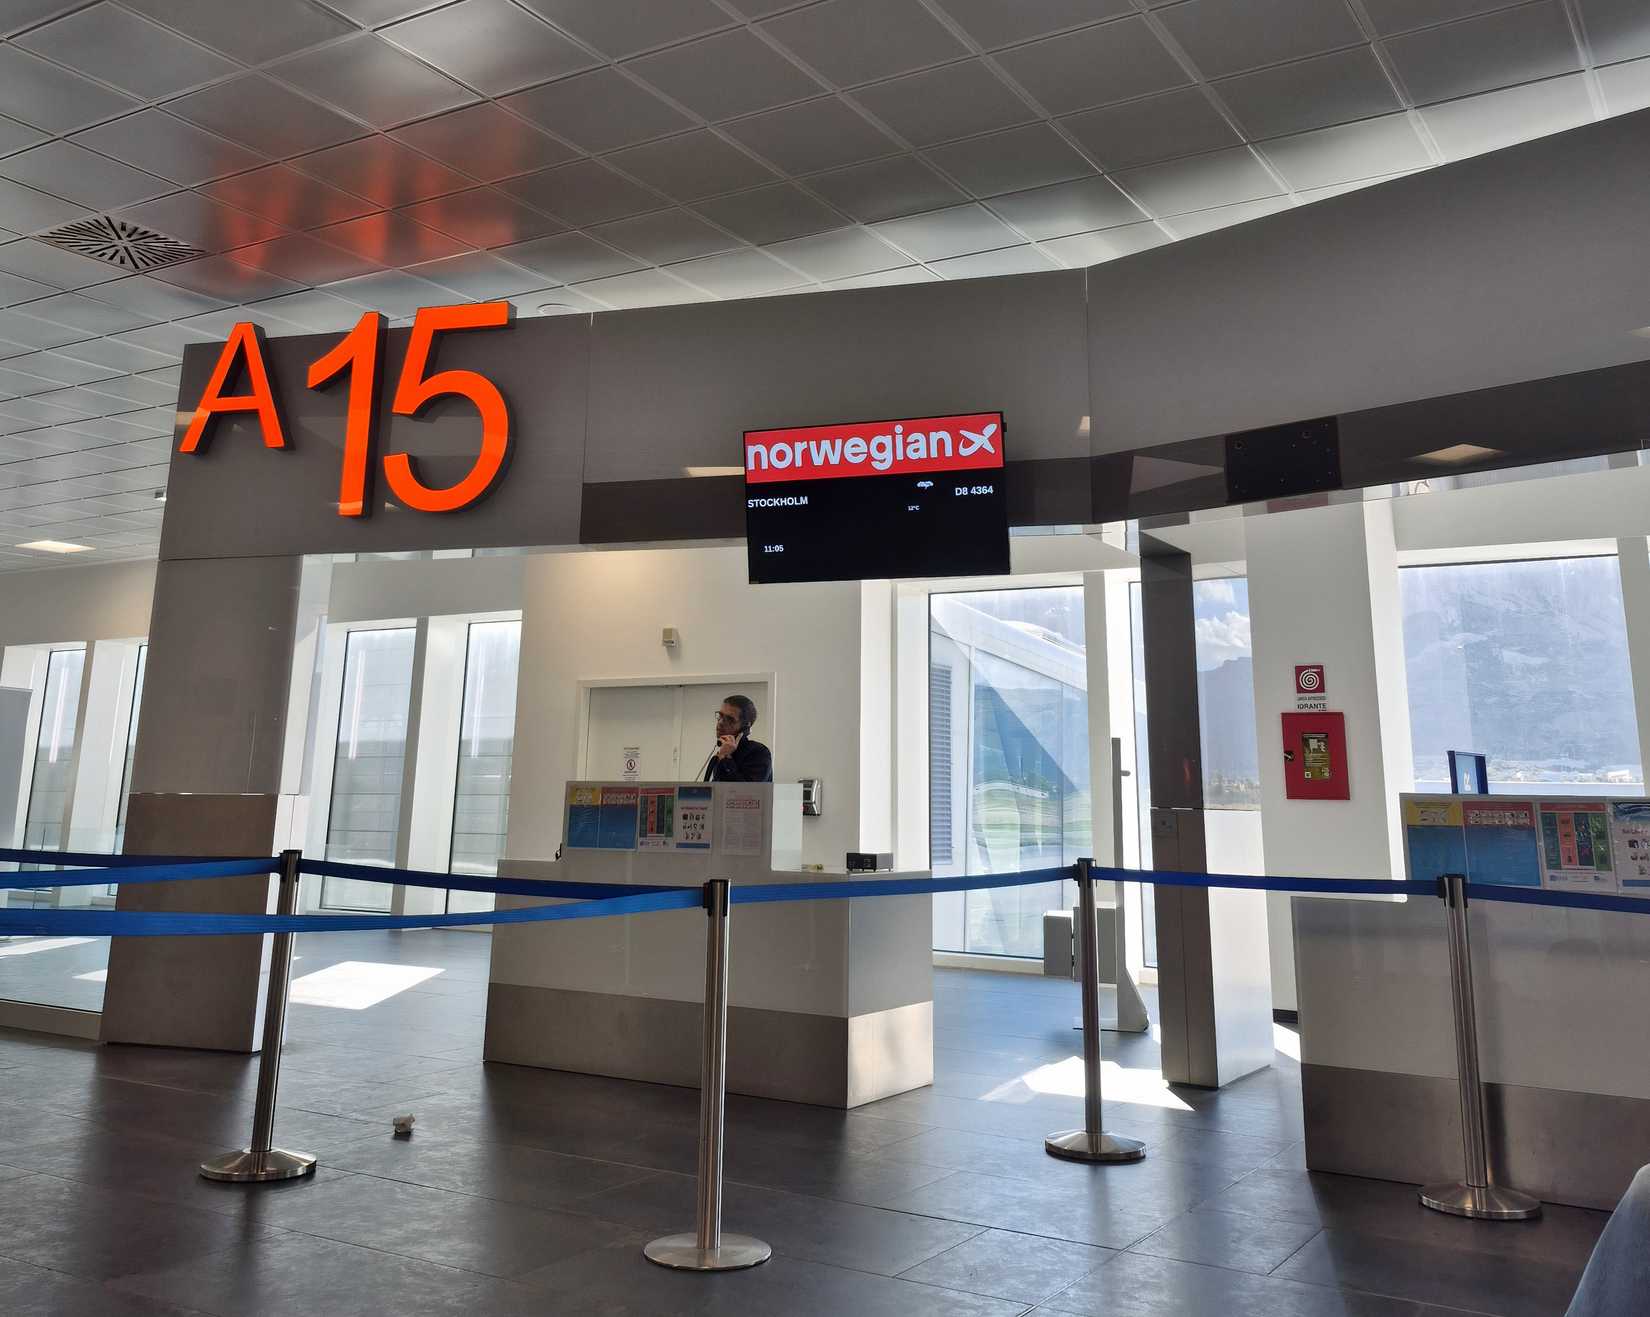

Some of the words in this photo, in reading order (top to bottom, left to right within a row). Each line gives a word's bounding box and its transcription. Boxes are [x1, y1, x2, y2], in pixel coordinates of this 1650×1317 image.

[178, 321, 287, 455] A
[306, 301, 516, 518] 15
[746, 424, 953, 471] norwegian
[955, 486, 968, 496] D8
[970, 485, 994, 495] 4364
[747, 496, 809, 508] STOCKHOLM
[764, 545, 784, 553] 11:05
